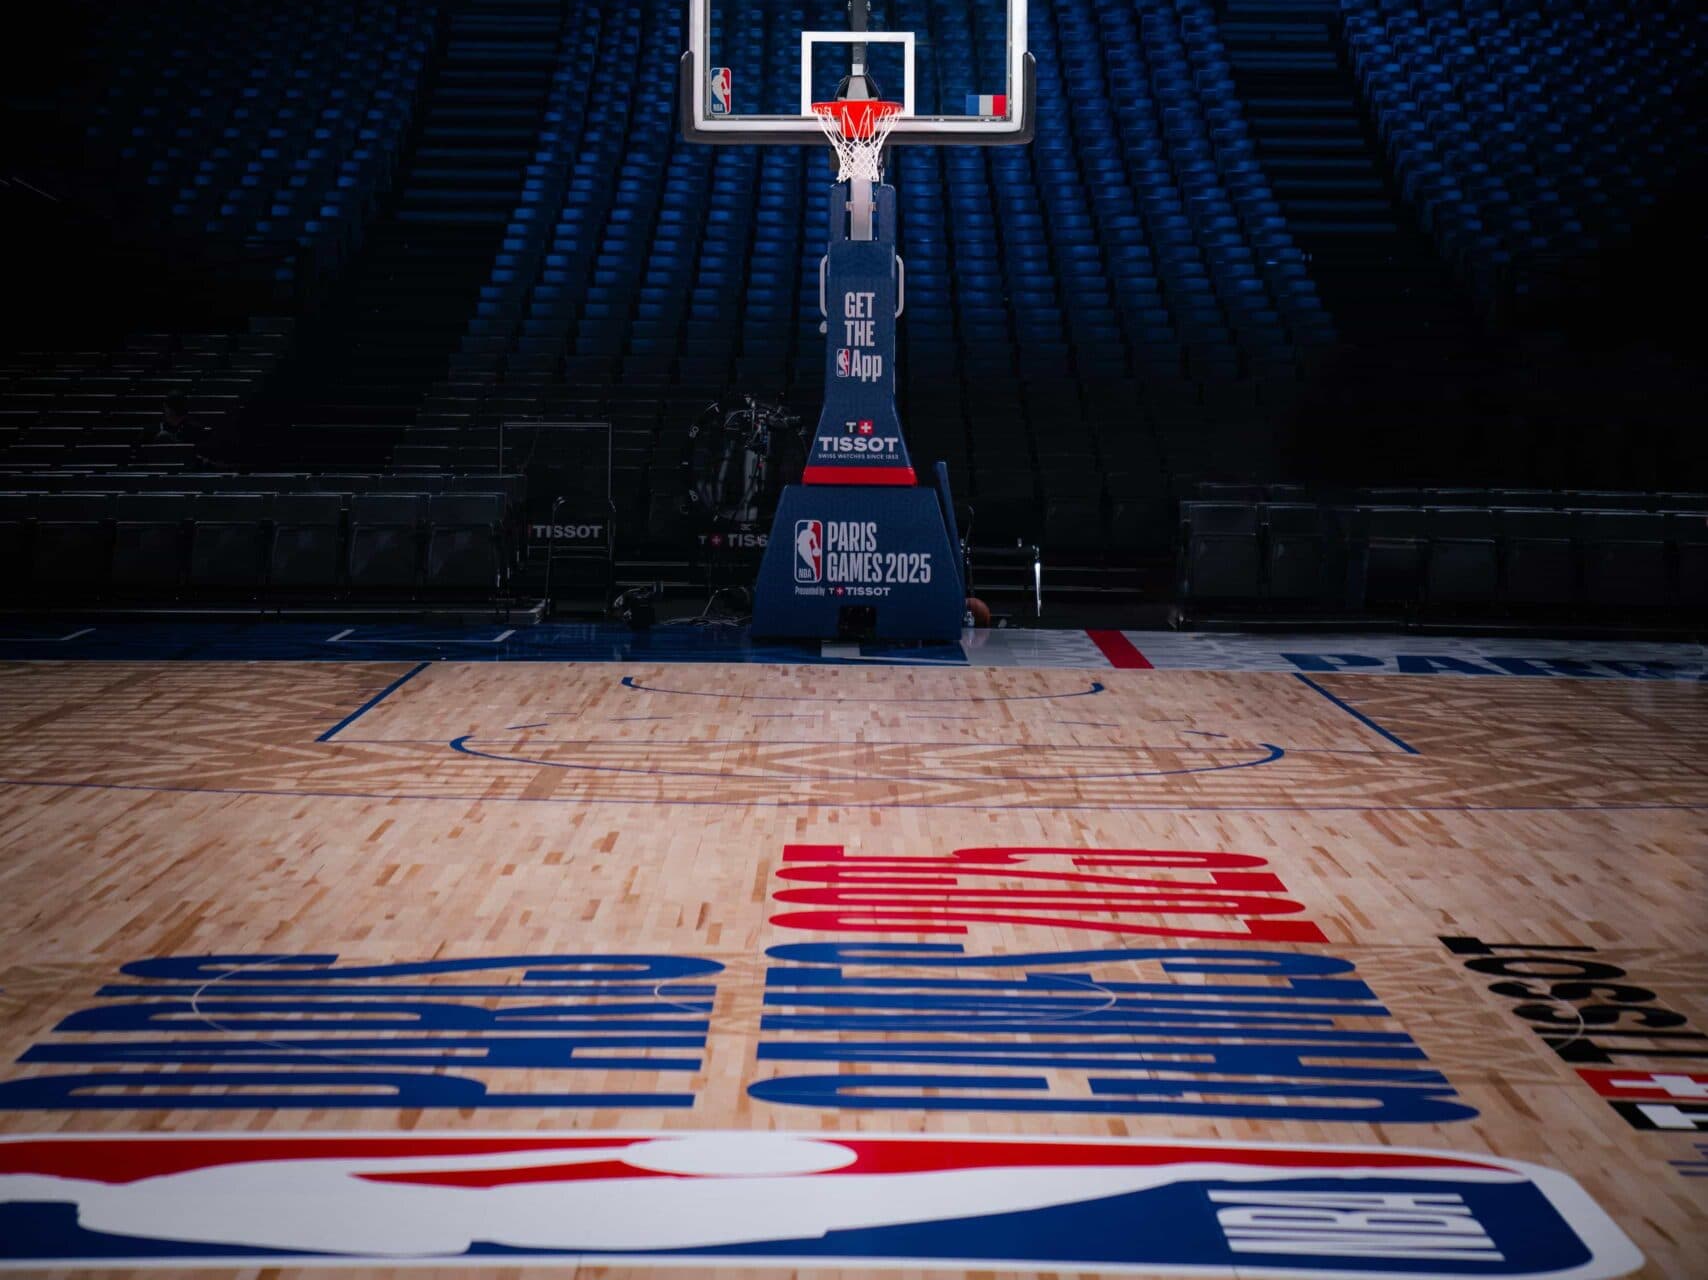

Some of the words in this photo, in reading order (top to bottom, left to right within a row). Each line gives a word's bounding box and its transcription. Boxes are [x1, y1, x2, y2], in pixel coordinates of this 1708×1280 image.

[844, 292, 876, 318] GET
[844, 320, 875, 347] THE
[851, 349, 883, 382] App
[846, 422, 857, 433] T
[818, 436, 899, 452] TISSOT
[533, 524, 603, 539] TISSOT
[727, 532, 768, 548] TISS
[826, 521, 878, 552] PARIS
[826, 552, 883, 583] GAMES
[884, 552, 932, 584] 2025
[845, 586, 892, 597] TISSOT
[768, 844, 1331, 944] 2025
[1437, 936, 1708, 1064] TISSOT
[0, 953, 727, 1109] PARIS
[747, 941, 1481, 1123] GAMES
[1207, 1189, 1506, 1262] NBA
